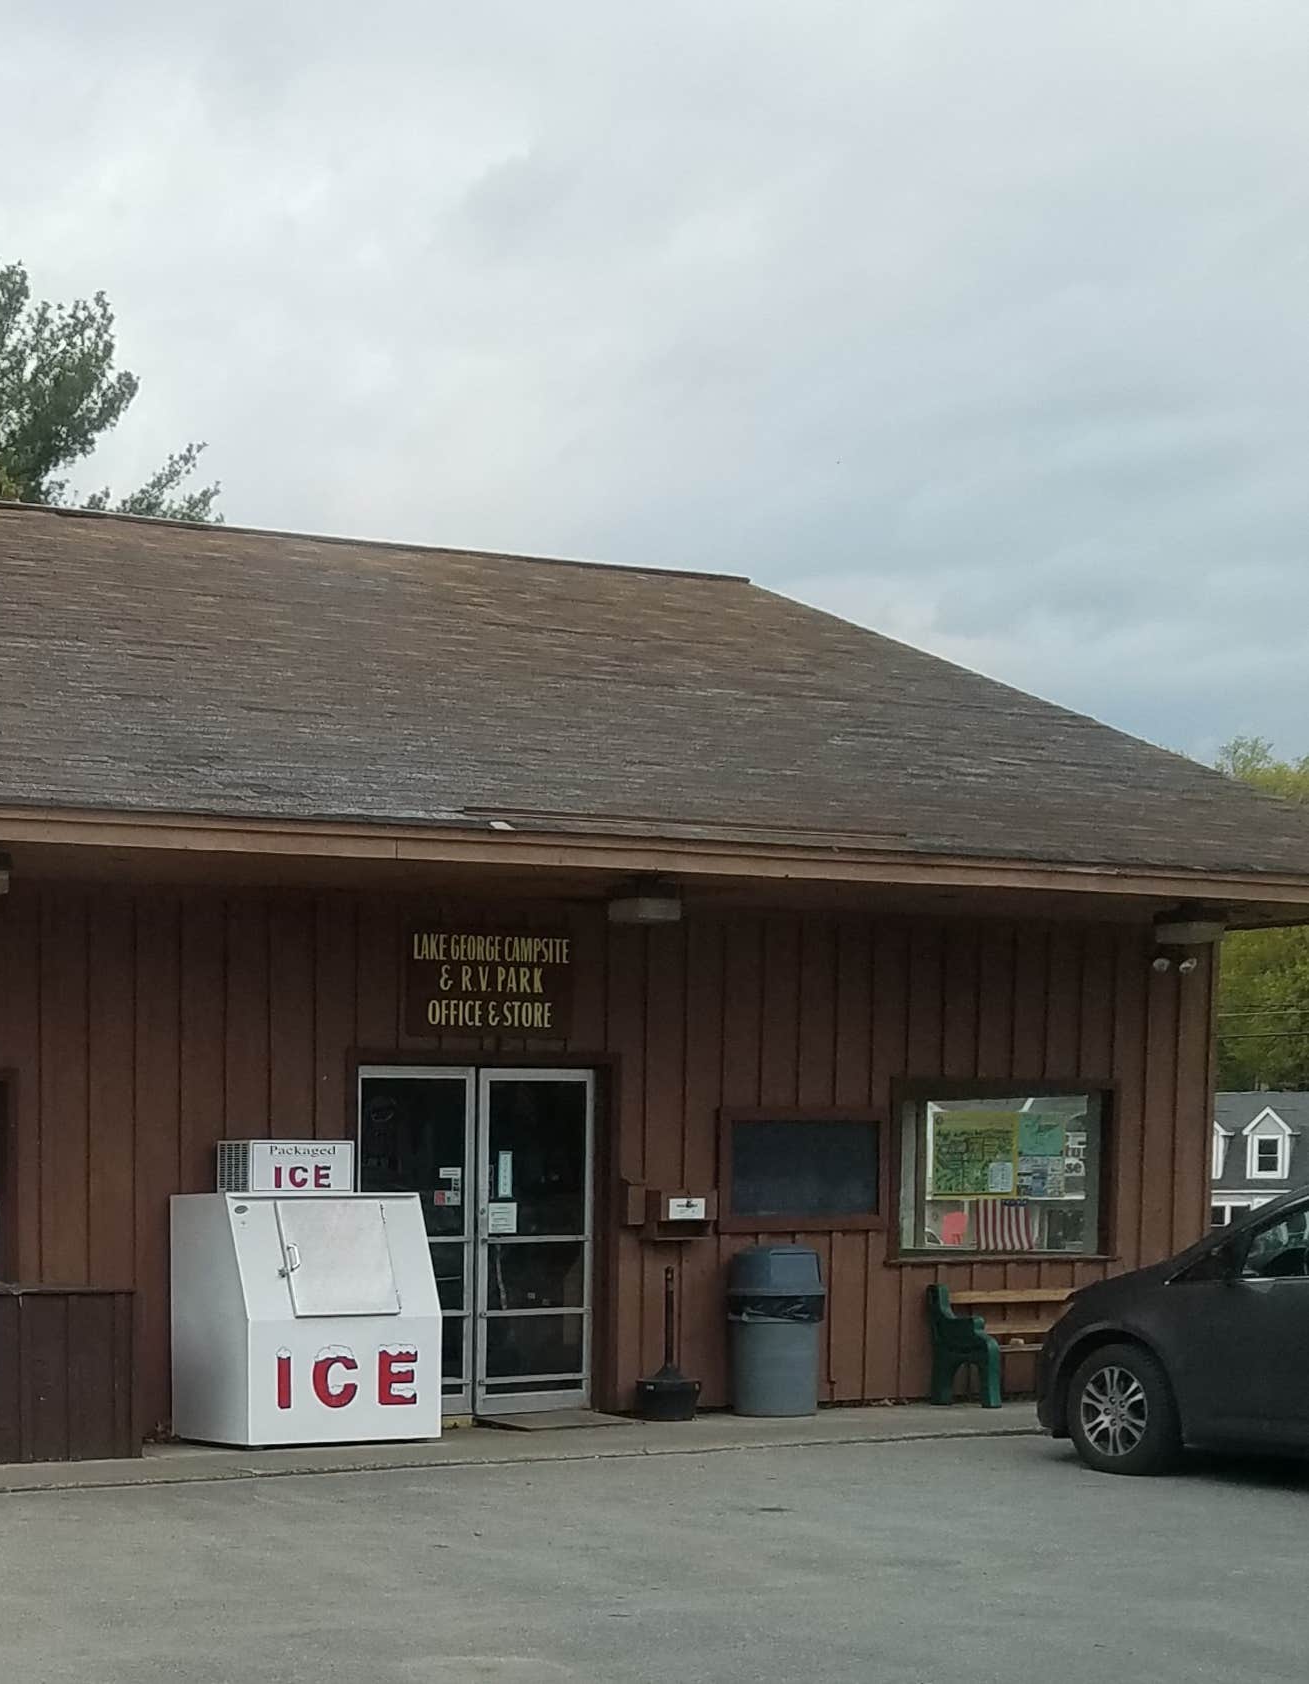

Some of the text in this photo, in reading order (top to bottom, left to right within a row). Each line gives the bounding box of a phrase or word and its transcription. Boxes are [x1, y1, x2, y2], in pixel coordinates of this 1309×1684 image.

[413, 933, 570, 964] LAKE GEORGE CAMPSITE
[439, 964, 453, 991] &
[497, 966, 544, 993] PARK
[427, 1000, 552, 1028] OFFICE & STORE
[269, 1145, 336, 1157] Packaged
[274, 1164, 332, 1189] ICE
[275, 1342, 419, 1409] ICE
